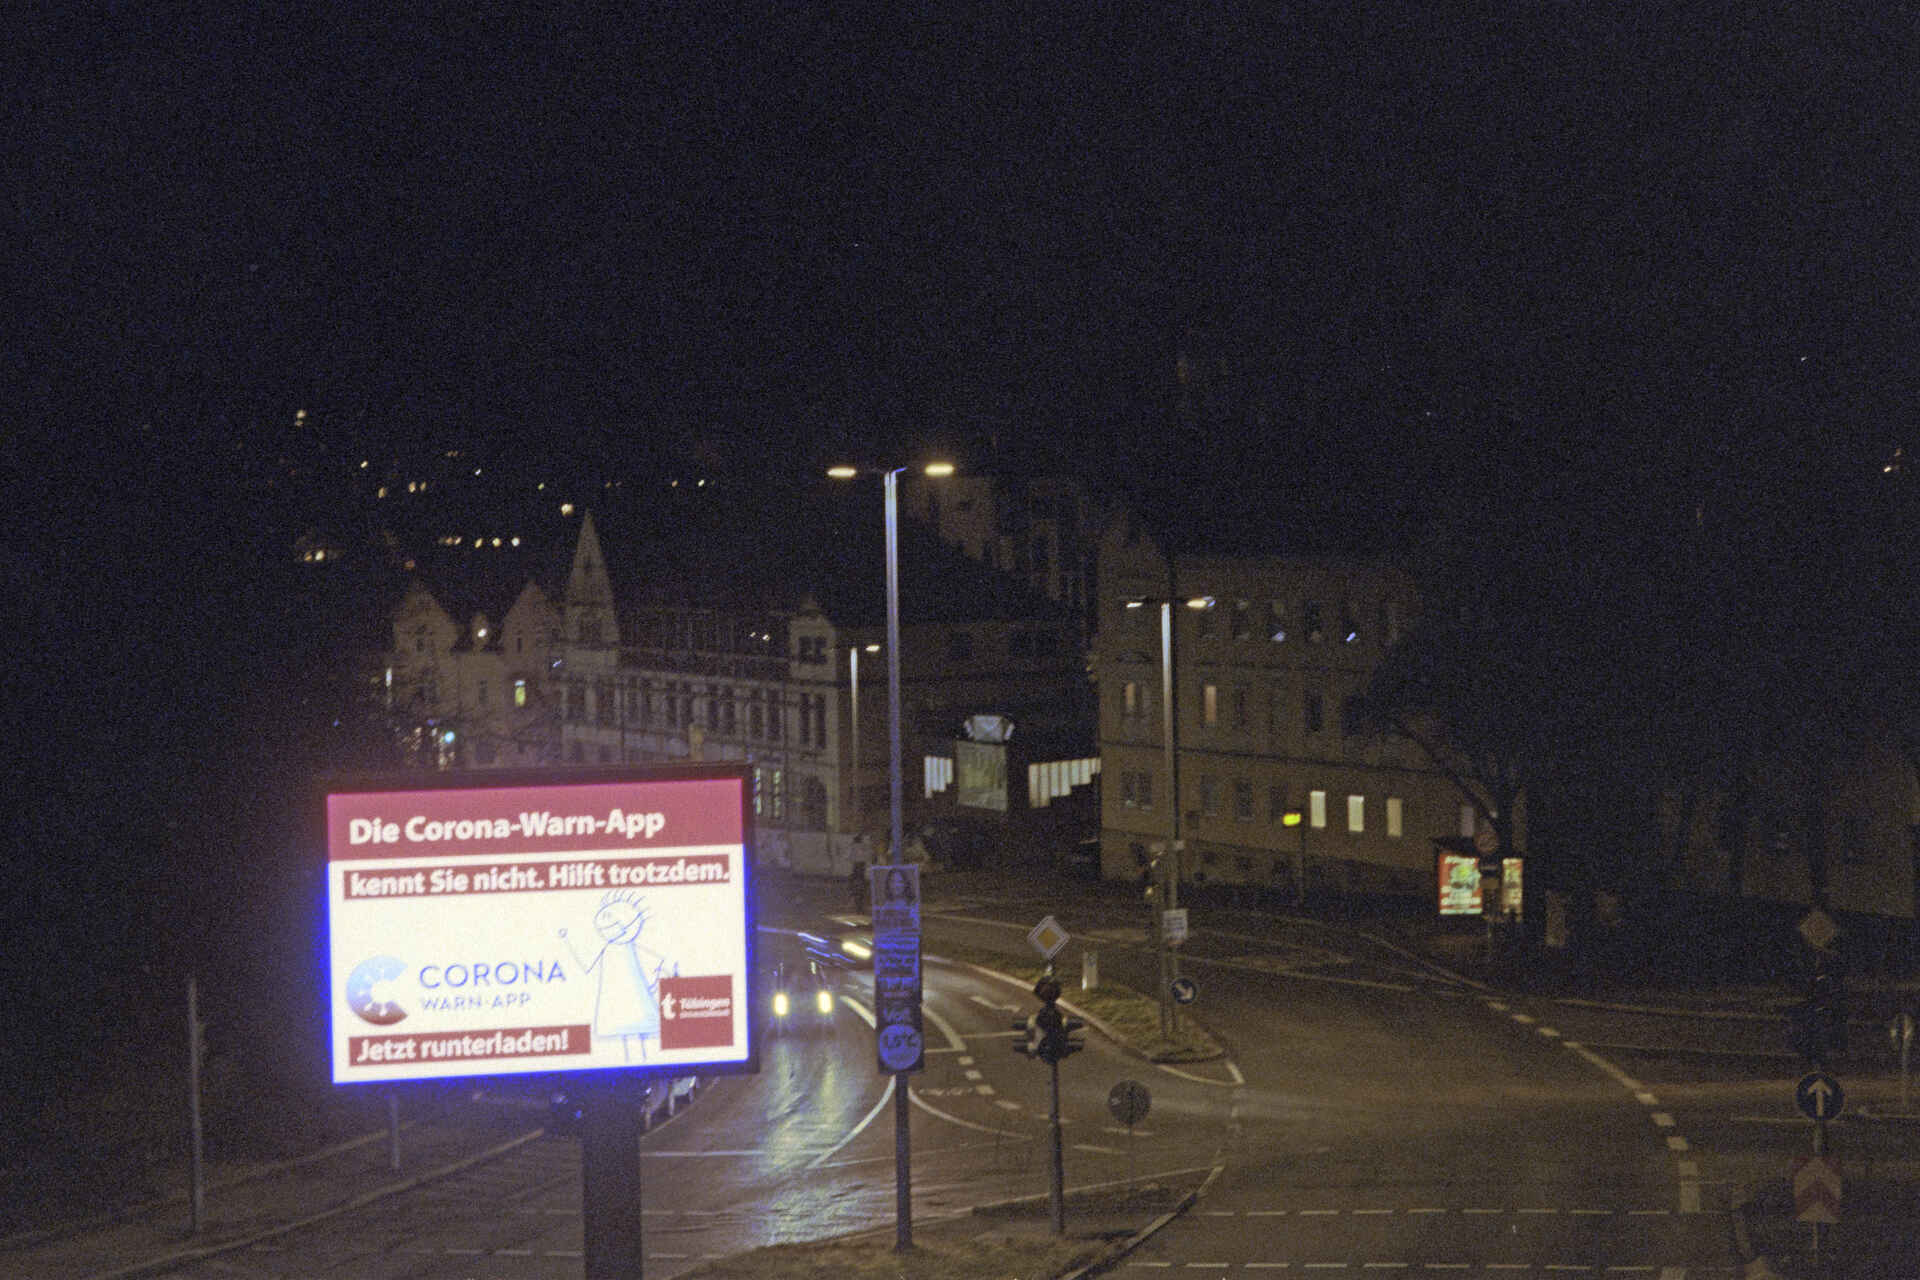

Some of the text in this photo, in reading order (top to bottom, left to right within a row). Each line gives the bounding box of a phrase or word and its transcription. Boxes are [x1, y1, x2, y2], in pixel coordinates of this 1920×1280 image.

[350, 808, 665, 844] Die Corona-Warn-App
[351, 858, 730, 896] kennt Sie nicht. Hilft trotzdem.
[419, 960, 567, 989] CORONA
[356, 1028, 569, 1062] Jetzt runterladen!
